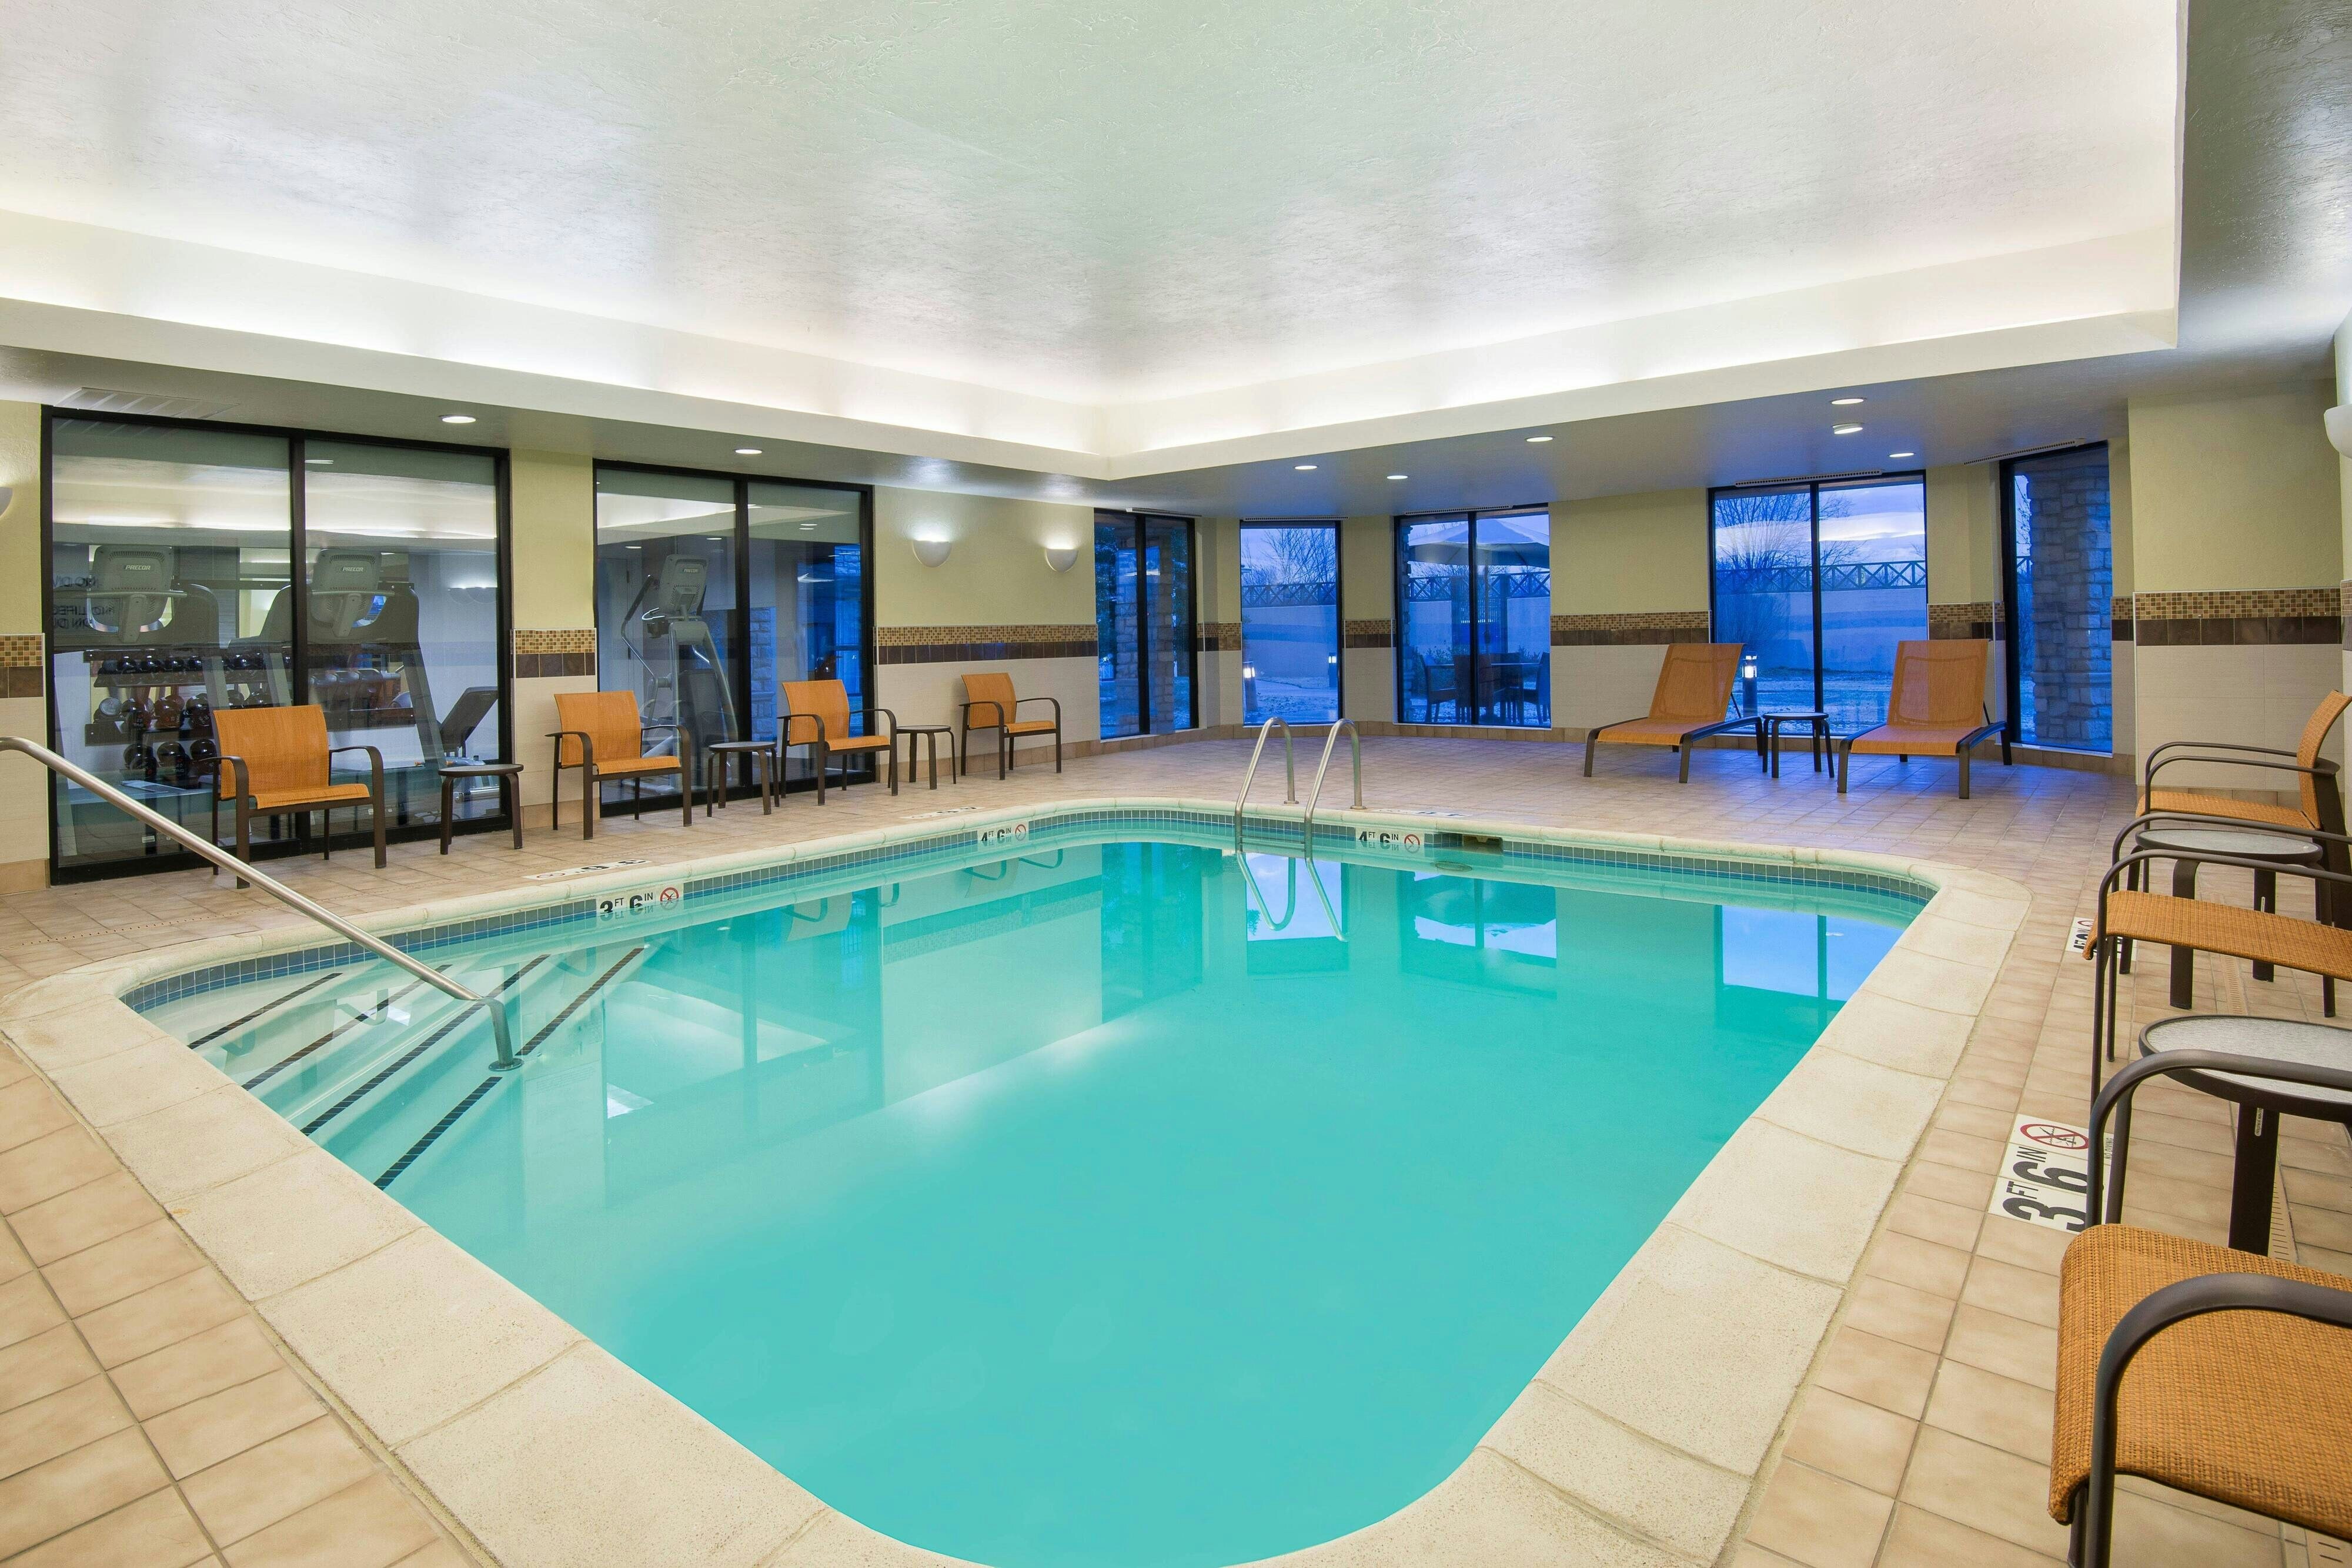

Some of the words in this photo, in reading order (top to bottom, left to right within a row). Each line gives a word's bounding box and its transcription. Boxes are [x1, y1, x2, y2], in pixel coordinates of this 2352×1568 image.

[614, 898, 624, 907] FT
[644, 892, 653, 901] IN
[2016, 1146, 2047, 1163] IN
[2012, 1161, 2087, 1195] 6
[2006, 1181, 2039, 1200] FT
[2002, 1197, 2087, 1232] 3
